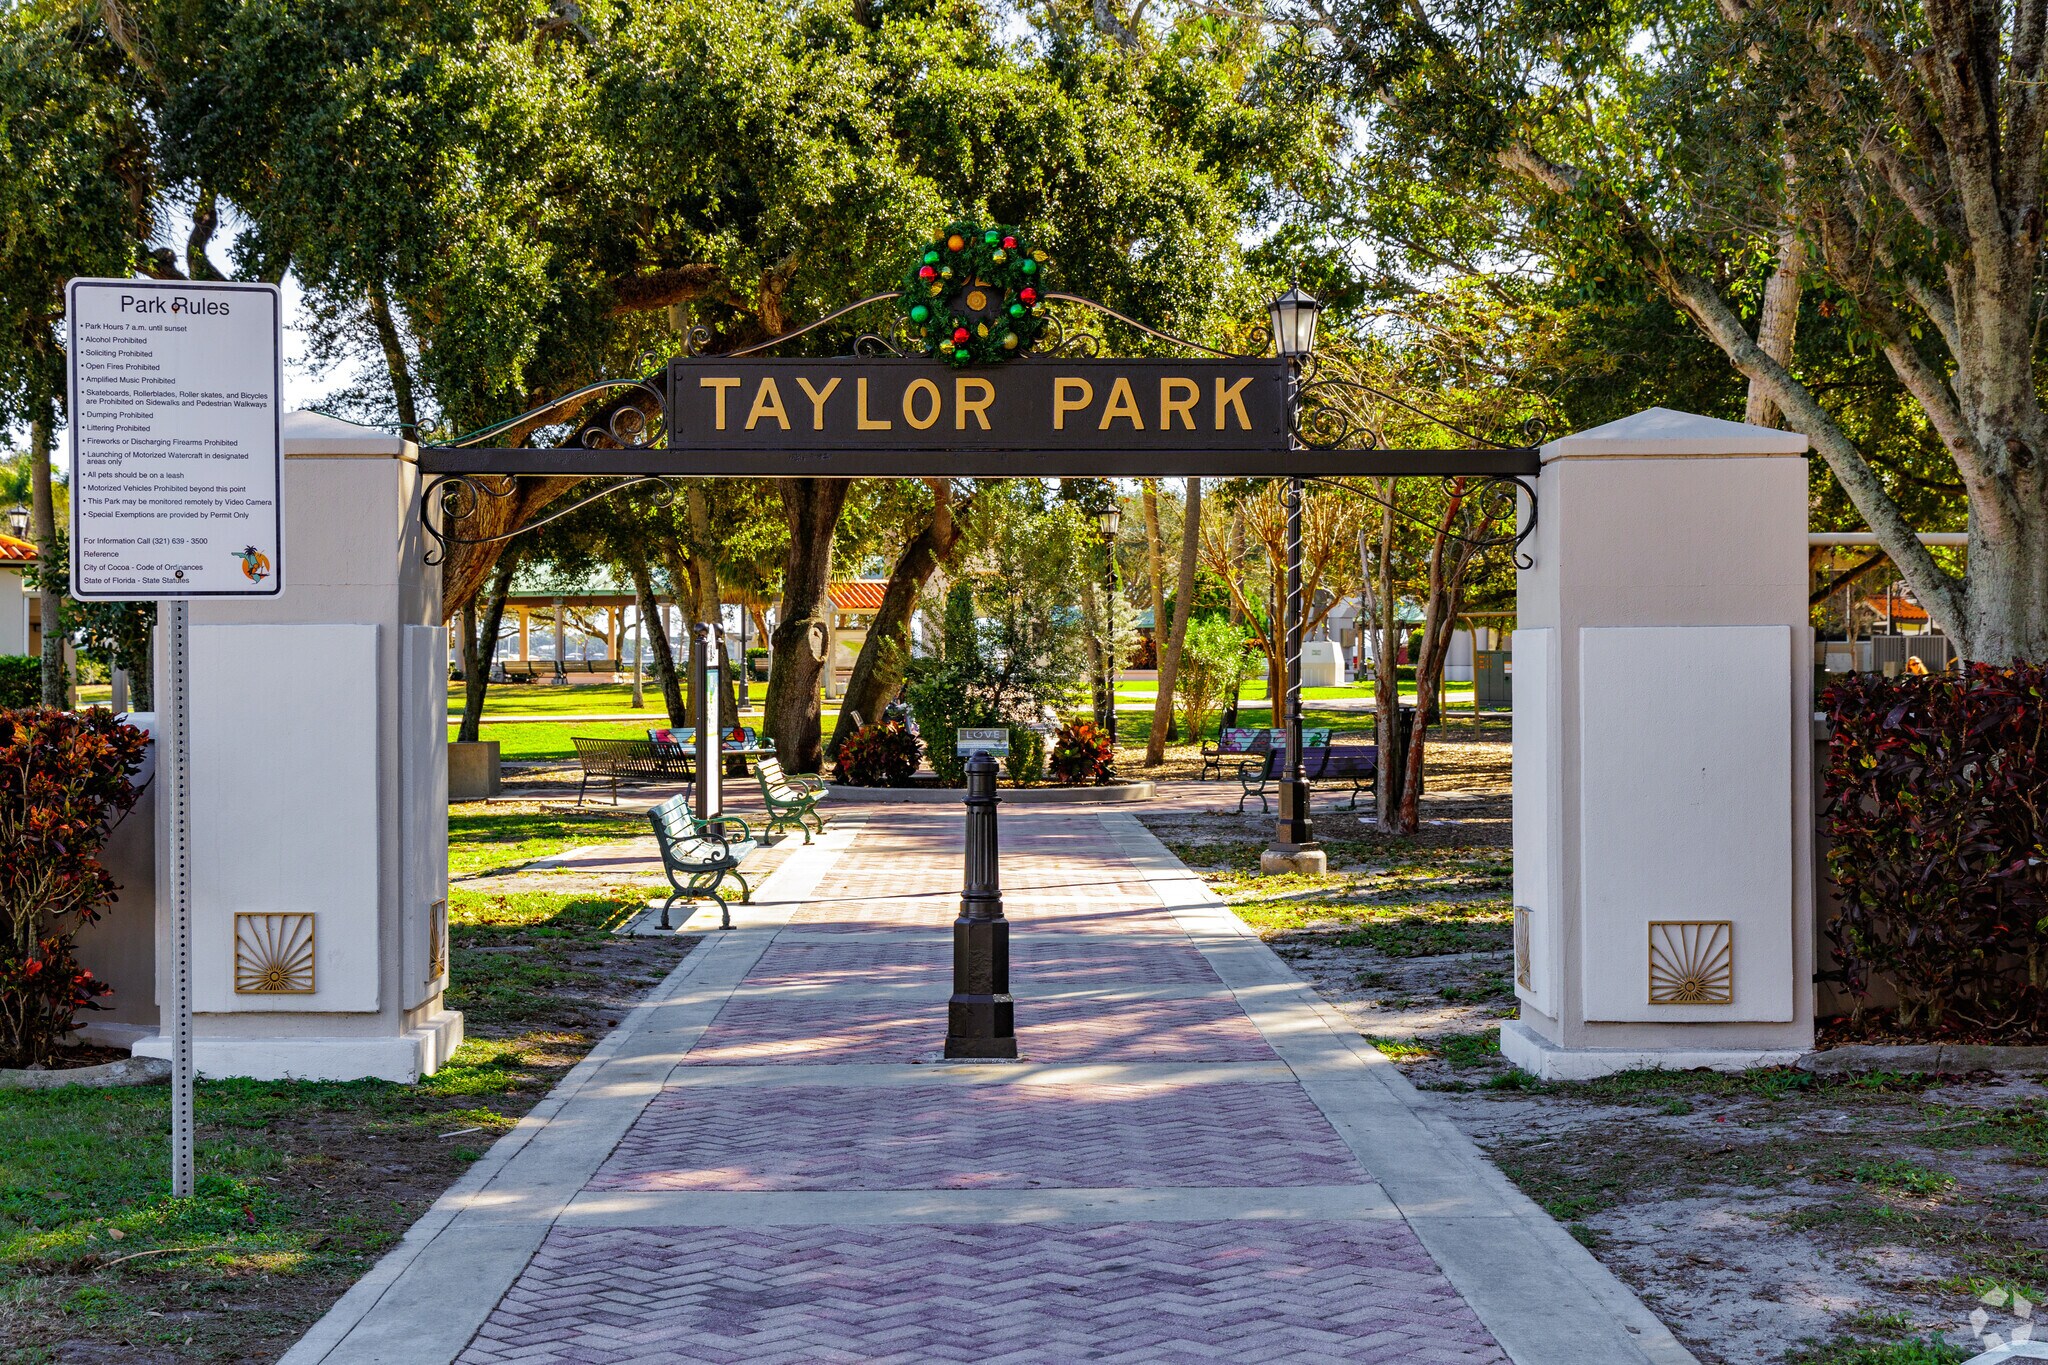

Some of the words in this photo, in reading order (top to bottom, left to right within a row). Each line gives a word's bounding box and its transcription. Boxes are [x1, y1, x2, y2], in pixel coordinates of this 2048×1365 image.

[121, 296, 166, 313] Park
[174, 297, 230, 315] Rules
[86, 350, 116, 358] Soliciting
[700, 377, 996, 431] TAYLOR
[1054, 377, 1254, 431] PARK
[131, 439, 170, 447] Discharging
[84, 564, 98, 572] City
[966, 730, 1000, 739] LOVE
